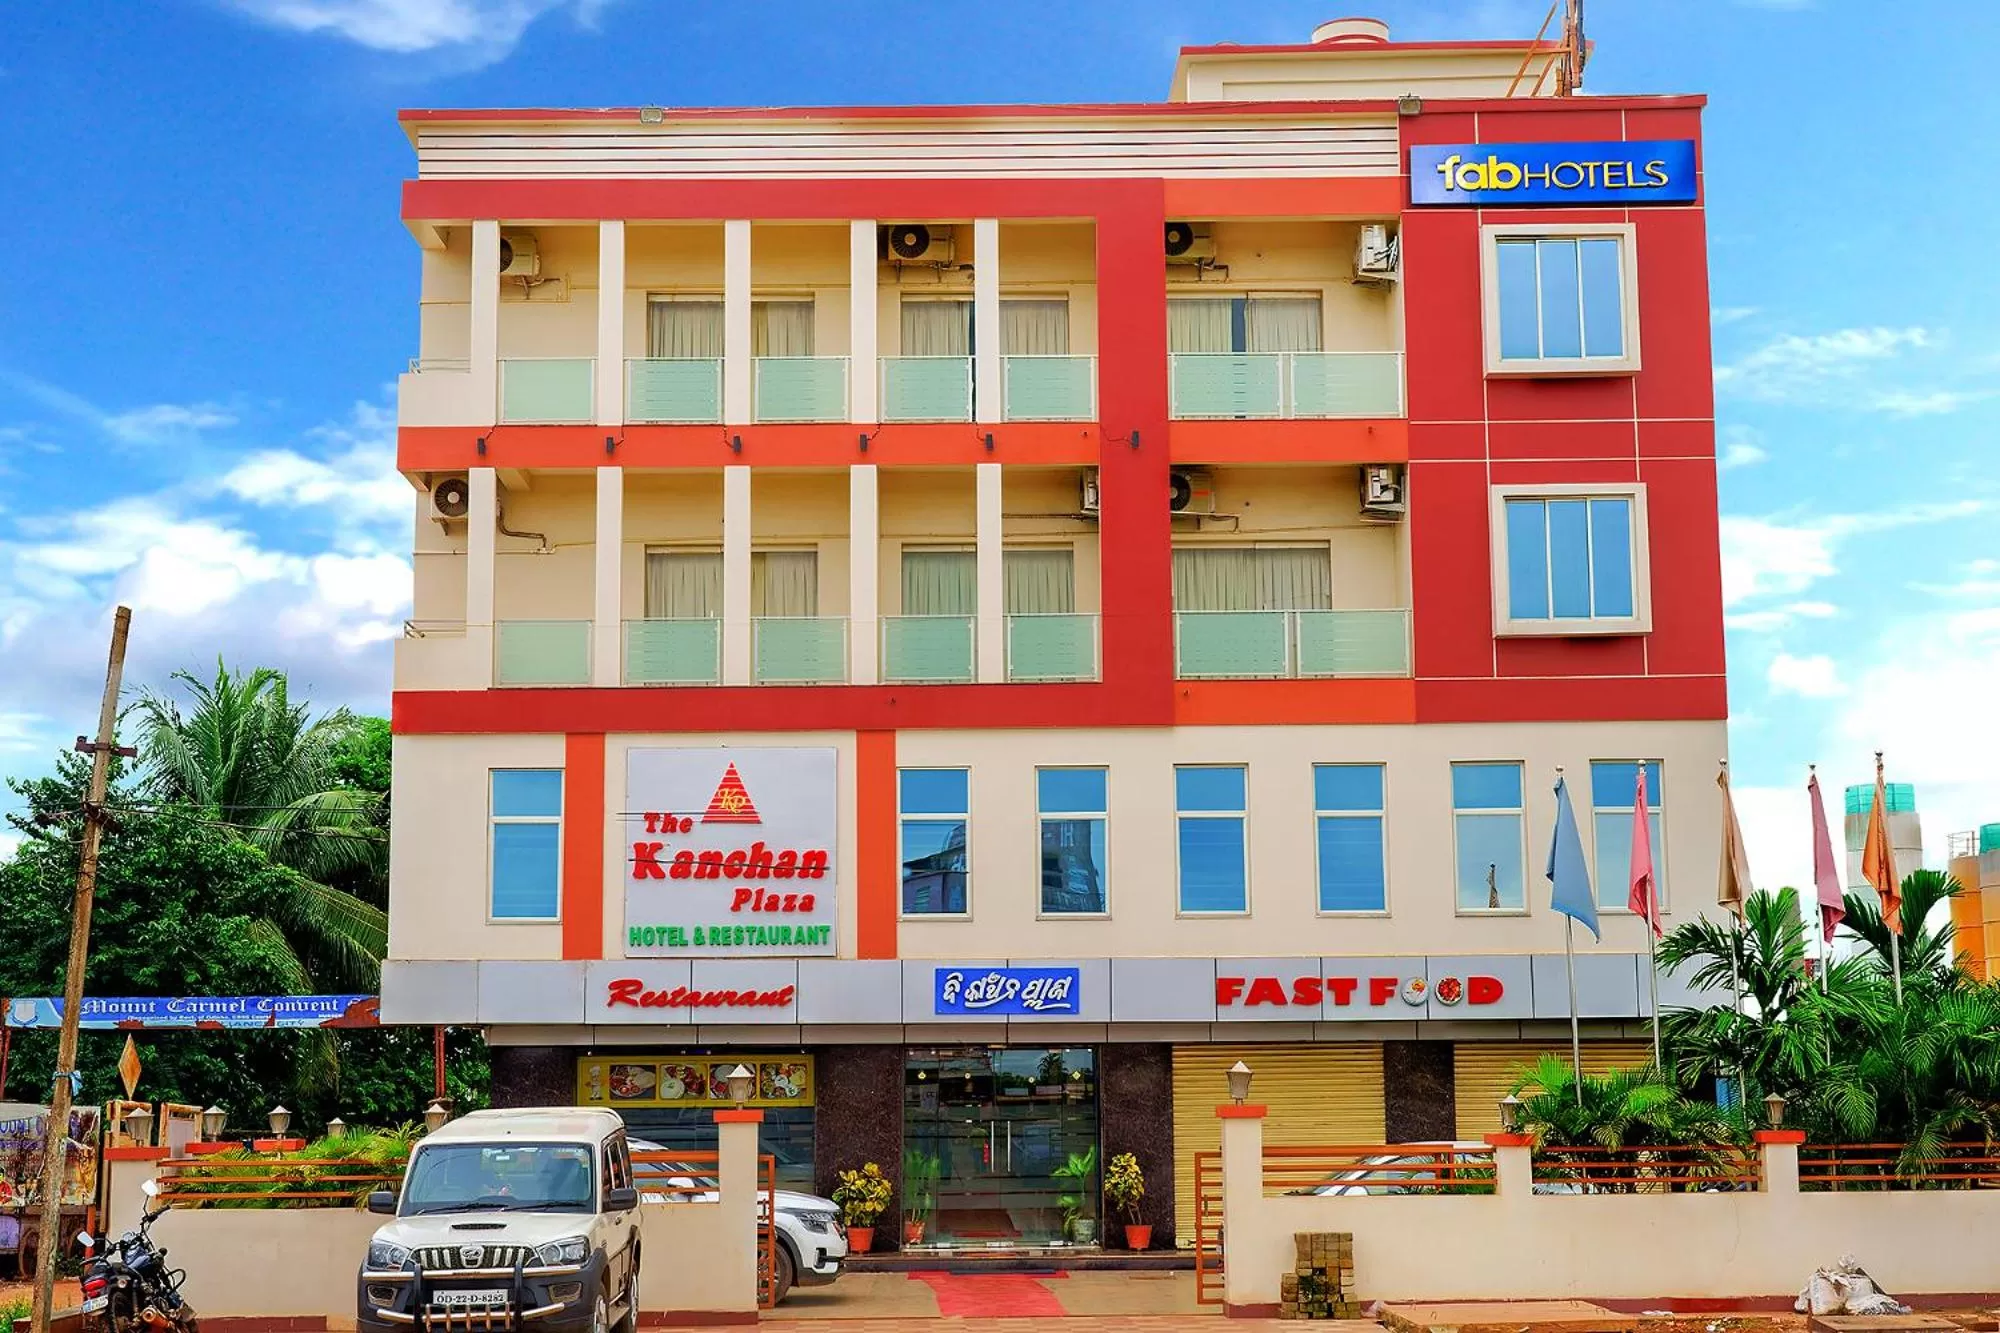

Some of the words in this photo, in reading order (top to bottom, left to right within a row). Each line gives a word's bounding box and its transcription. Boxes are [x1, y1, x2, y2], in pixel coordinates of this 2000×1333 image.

[643, 811, 693, 834] The
[632, 841, 828, 880] Kanchan
[730, 887, 816, 912] Plaza
[629, 926, 688, 947] HOTEL
[693, 926, 705, 947] &
[709, 925, 831, 946] RESTAURANT
[607, 978, 795, 1008] Restaurant
[1216, 977, 1358, 1007] FAST
[80, 999, 156, 1014] Mount
[167, 998, 246, 1013] Carmel
[257, 998, 339, 1012] Convent
